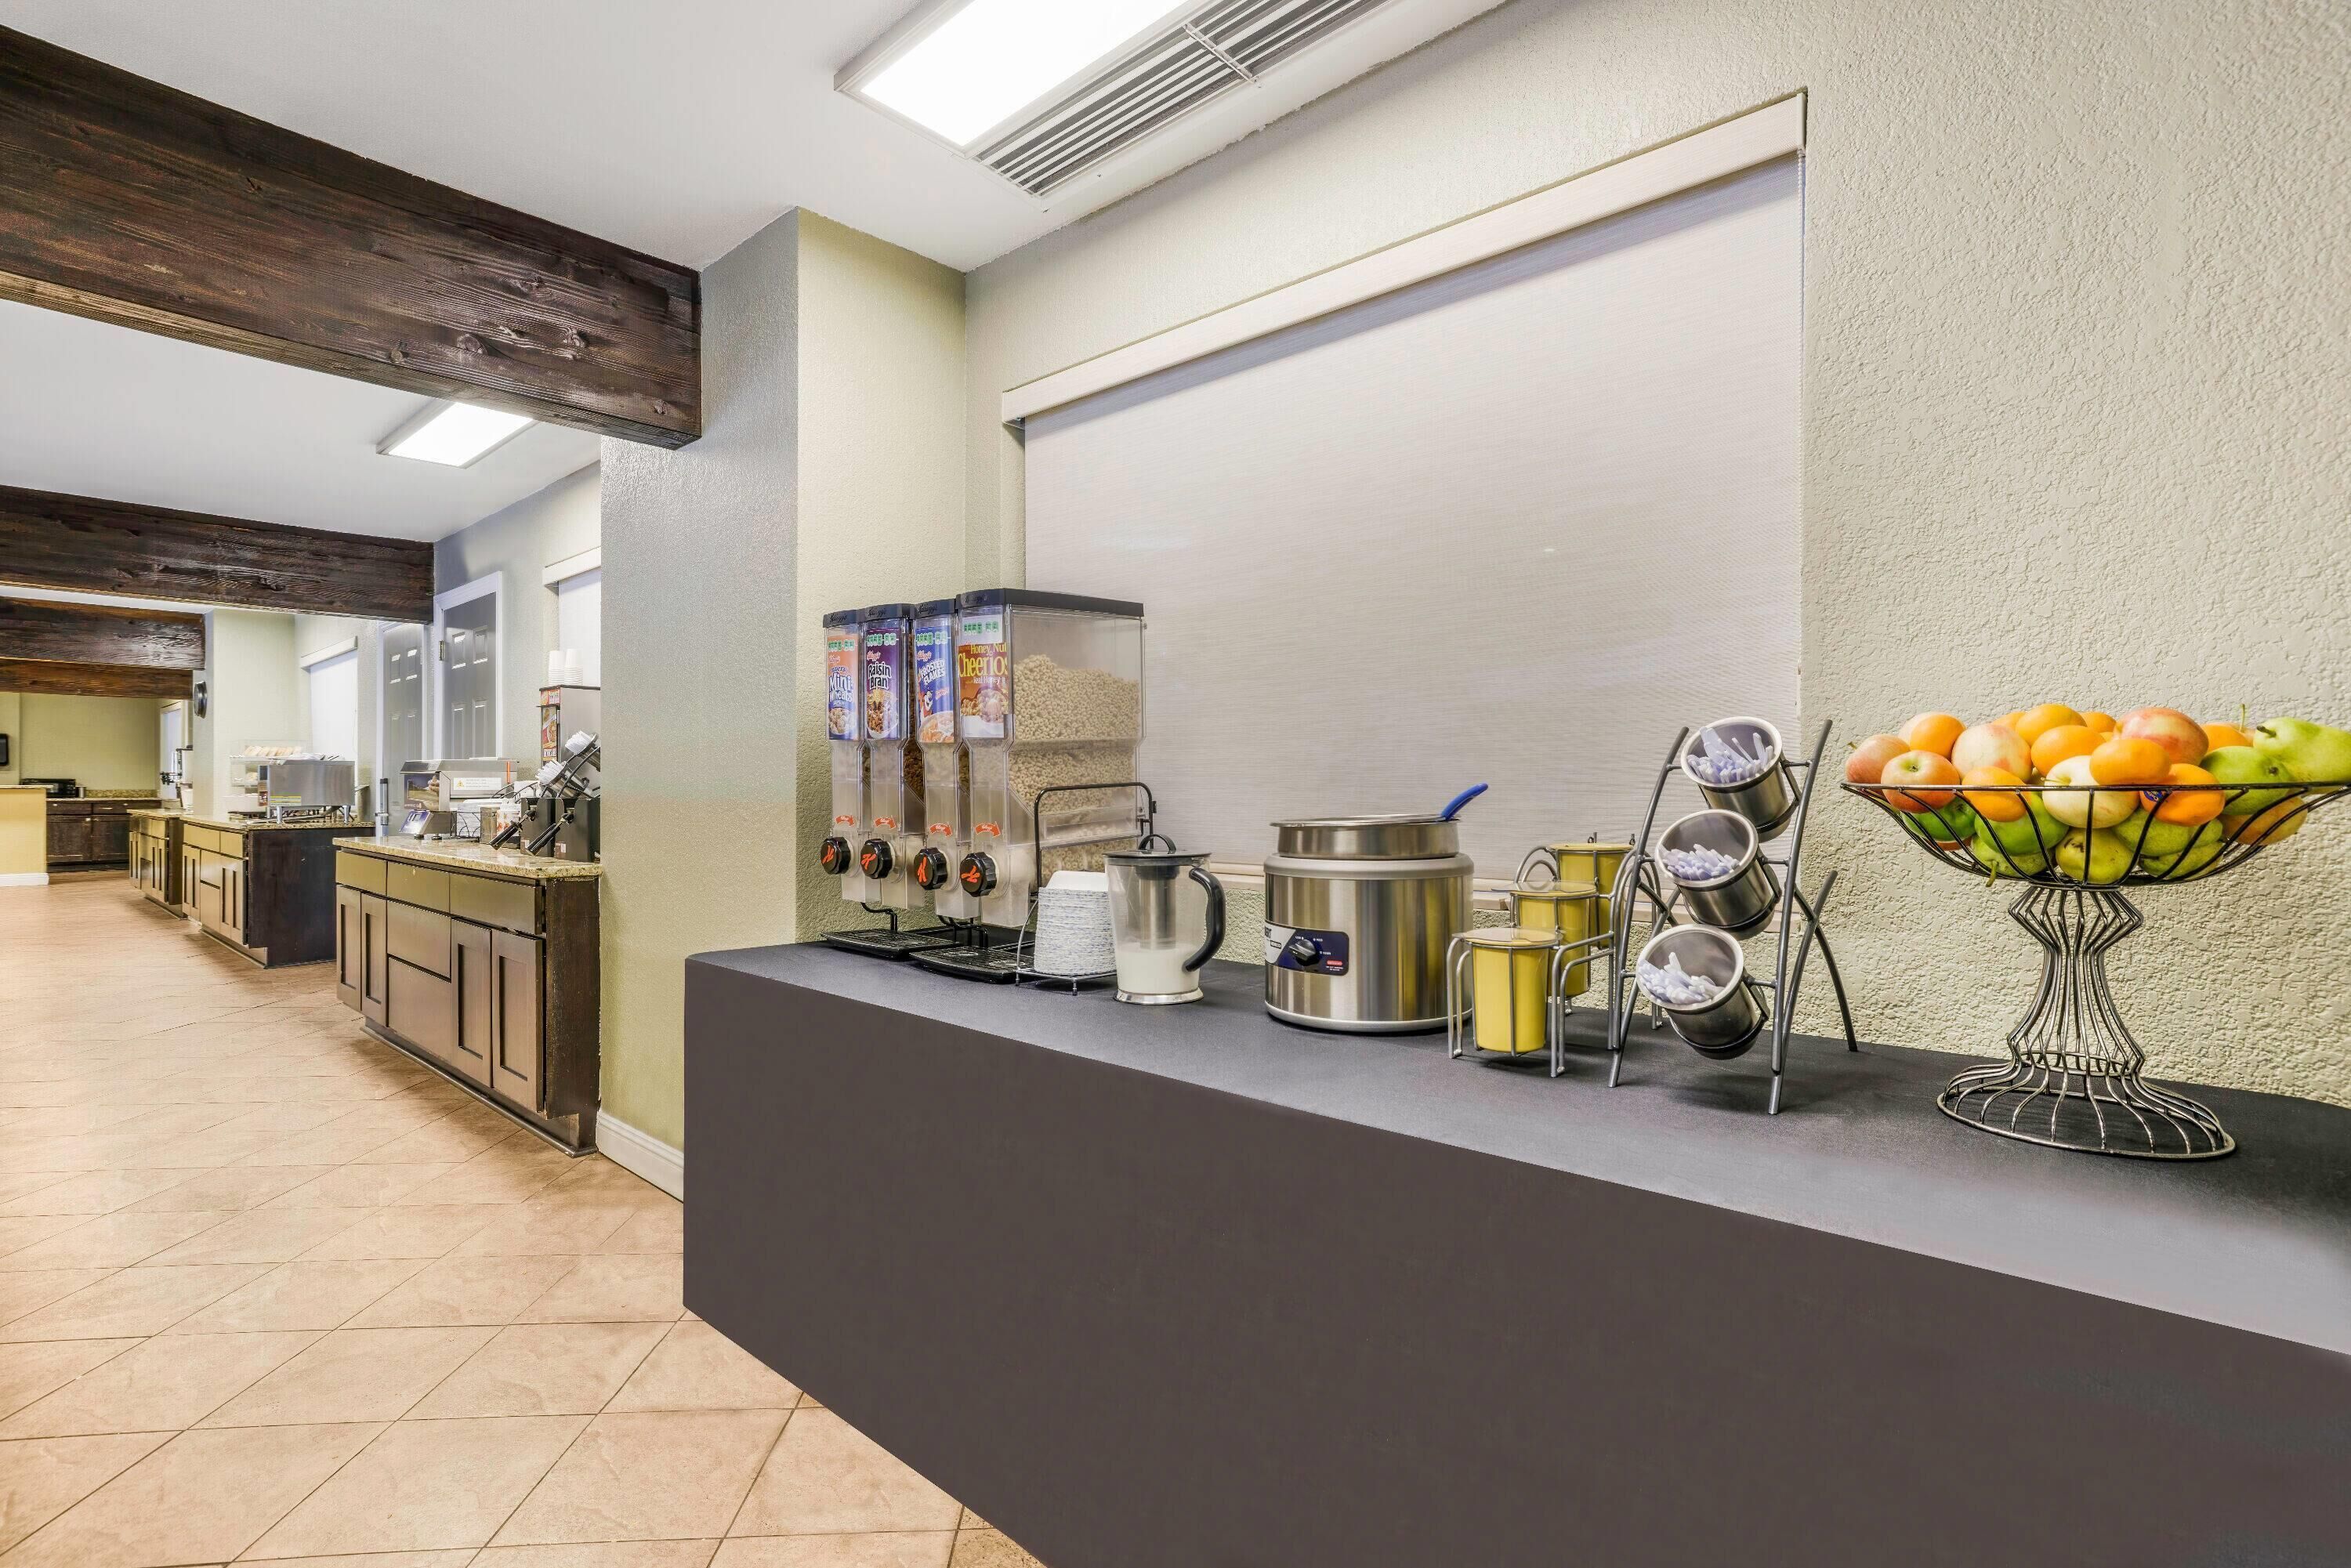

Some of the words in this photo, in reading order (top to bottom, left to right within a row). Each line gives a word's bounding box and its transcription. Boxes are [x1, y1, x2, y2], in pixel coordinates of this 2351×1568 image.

[970, 643, 991, 654] Honey
[868, 661, 892, 679] Raisin
[870, 675, 889, 690] Bran
